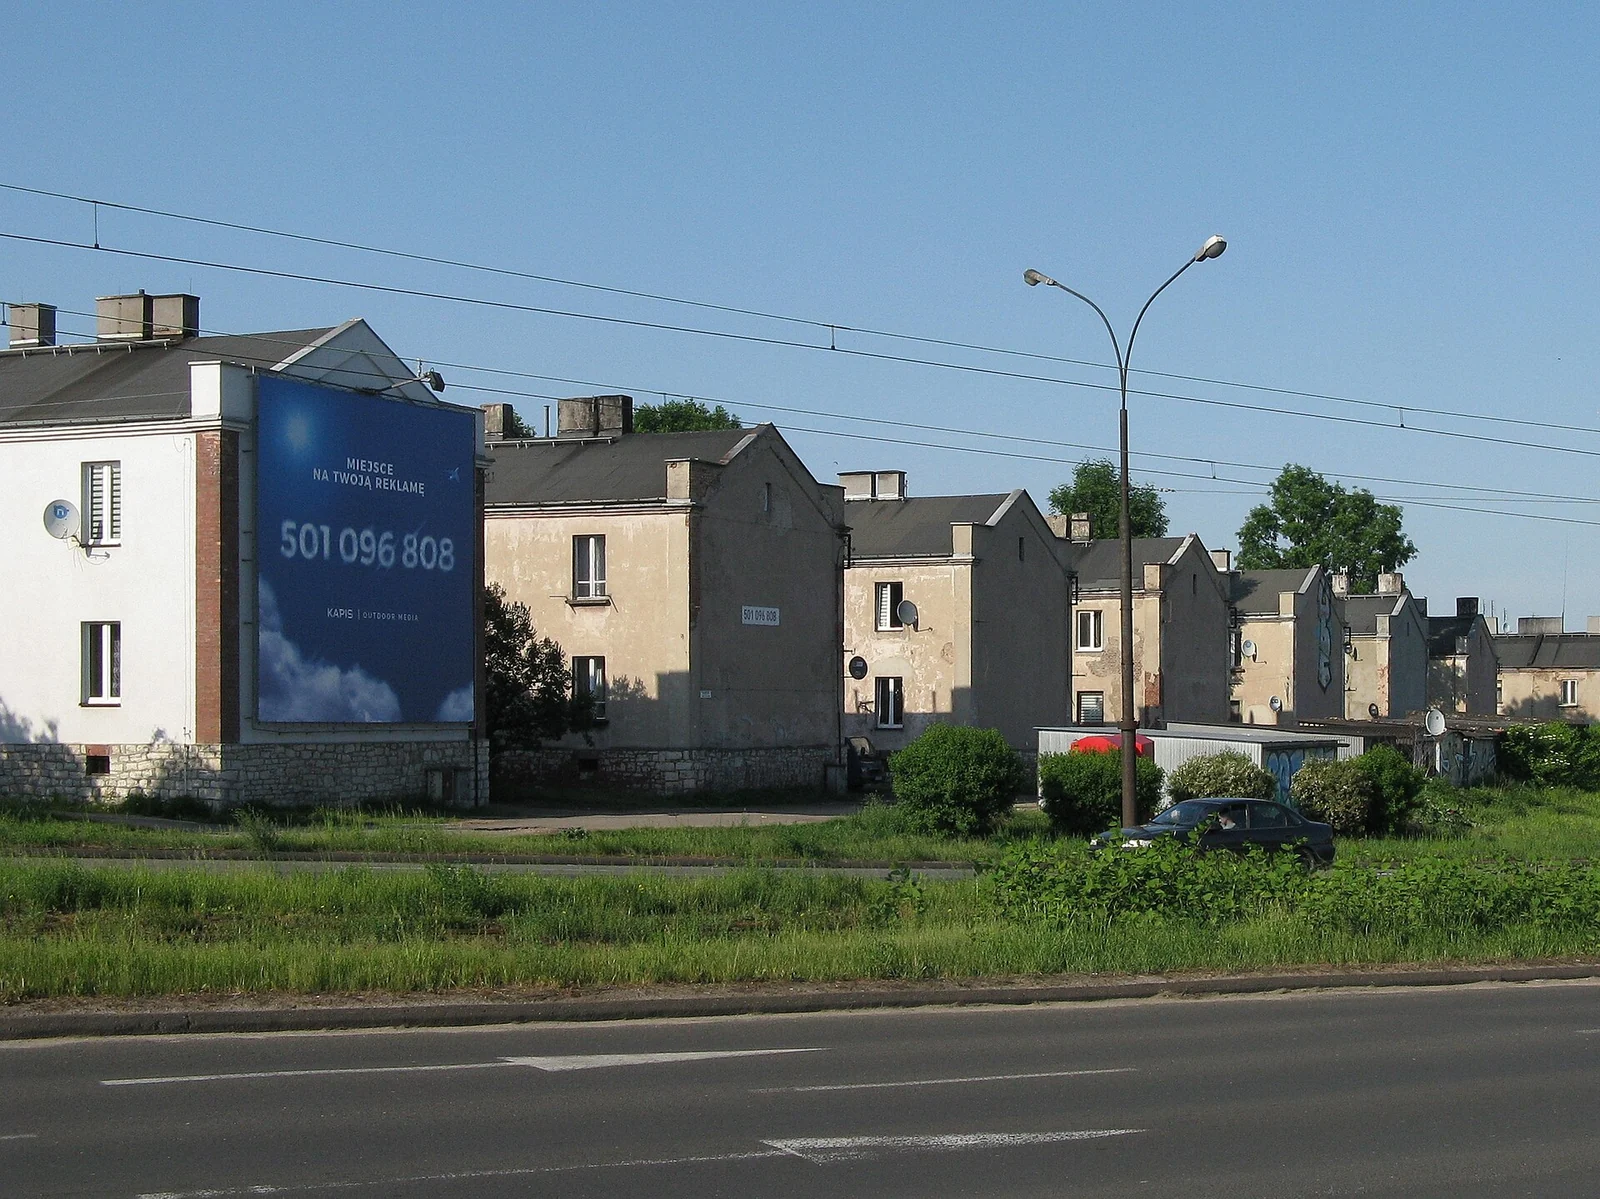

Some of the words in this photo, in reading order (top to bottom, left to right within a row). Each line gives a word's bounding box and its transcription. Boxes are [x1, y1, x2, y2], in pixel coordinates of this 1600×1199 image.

[346, 457, 394, 476] MIEJSCE
[313, 468, 329, 482] NA
[333, 471, 372, 491] TWOJĄ
[375, 477, 425, 497] REKLAMĘ
[281, 520, 331, 560] 501
[338, 527, 396, 567] 096
[402, 533, 454, 572] 808
[327, 608, 354, 619] KAPIS
[363, 611, 396, 620] OUTDOOR
[398, 613, 419, 621] MEDIA
[744, 609, 753, 620] 501
